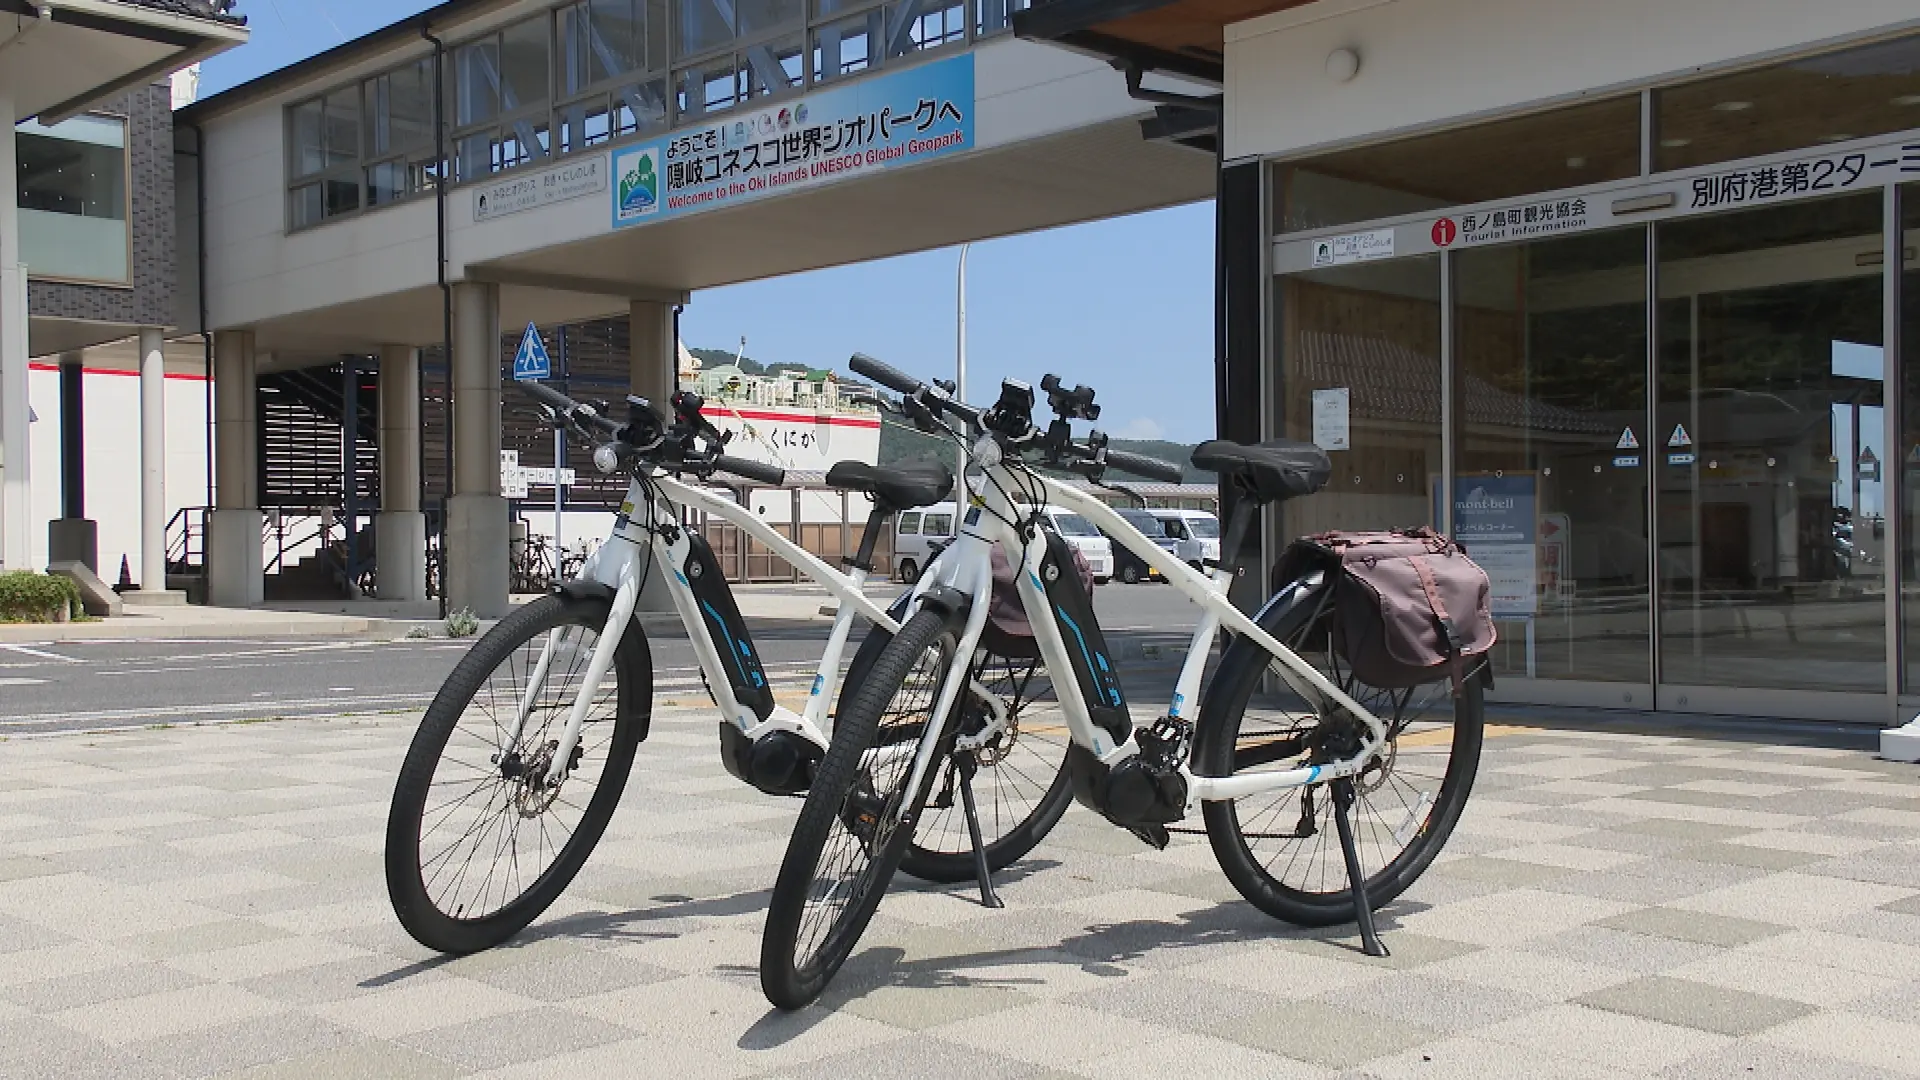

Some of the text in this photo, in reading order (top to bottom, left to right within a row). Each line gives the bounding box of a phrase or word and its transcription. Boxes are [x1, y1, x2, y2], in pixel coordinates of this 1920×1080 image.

[667, 126, 725, 159] ようこそ！
[667, 99, 962, 192] 隠岐ユネスコ世界ジオパークへ
[668, 129, 963, 209] Welcome to the Oki Islands UNESCO Global Geopark
[1462, 198, 1587, 233] 西ノ島町観光協会
[1464, 218, 1587, 243] Tourist Information
[771, 428, 816, 449] くにが
